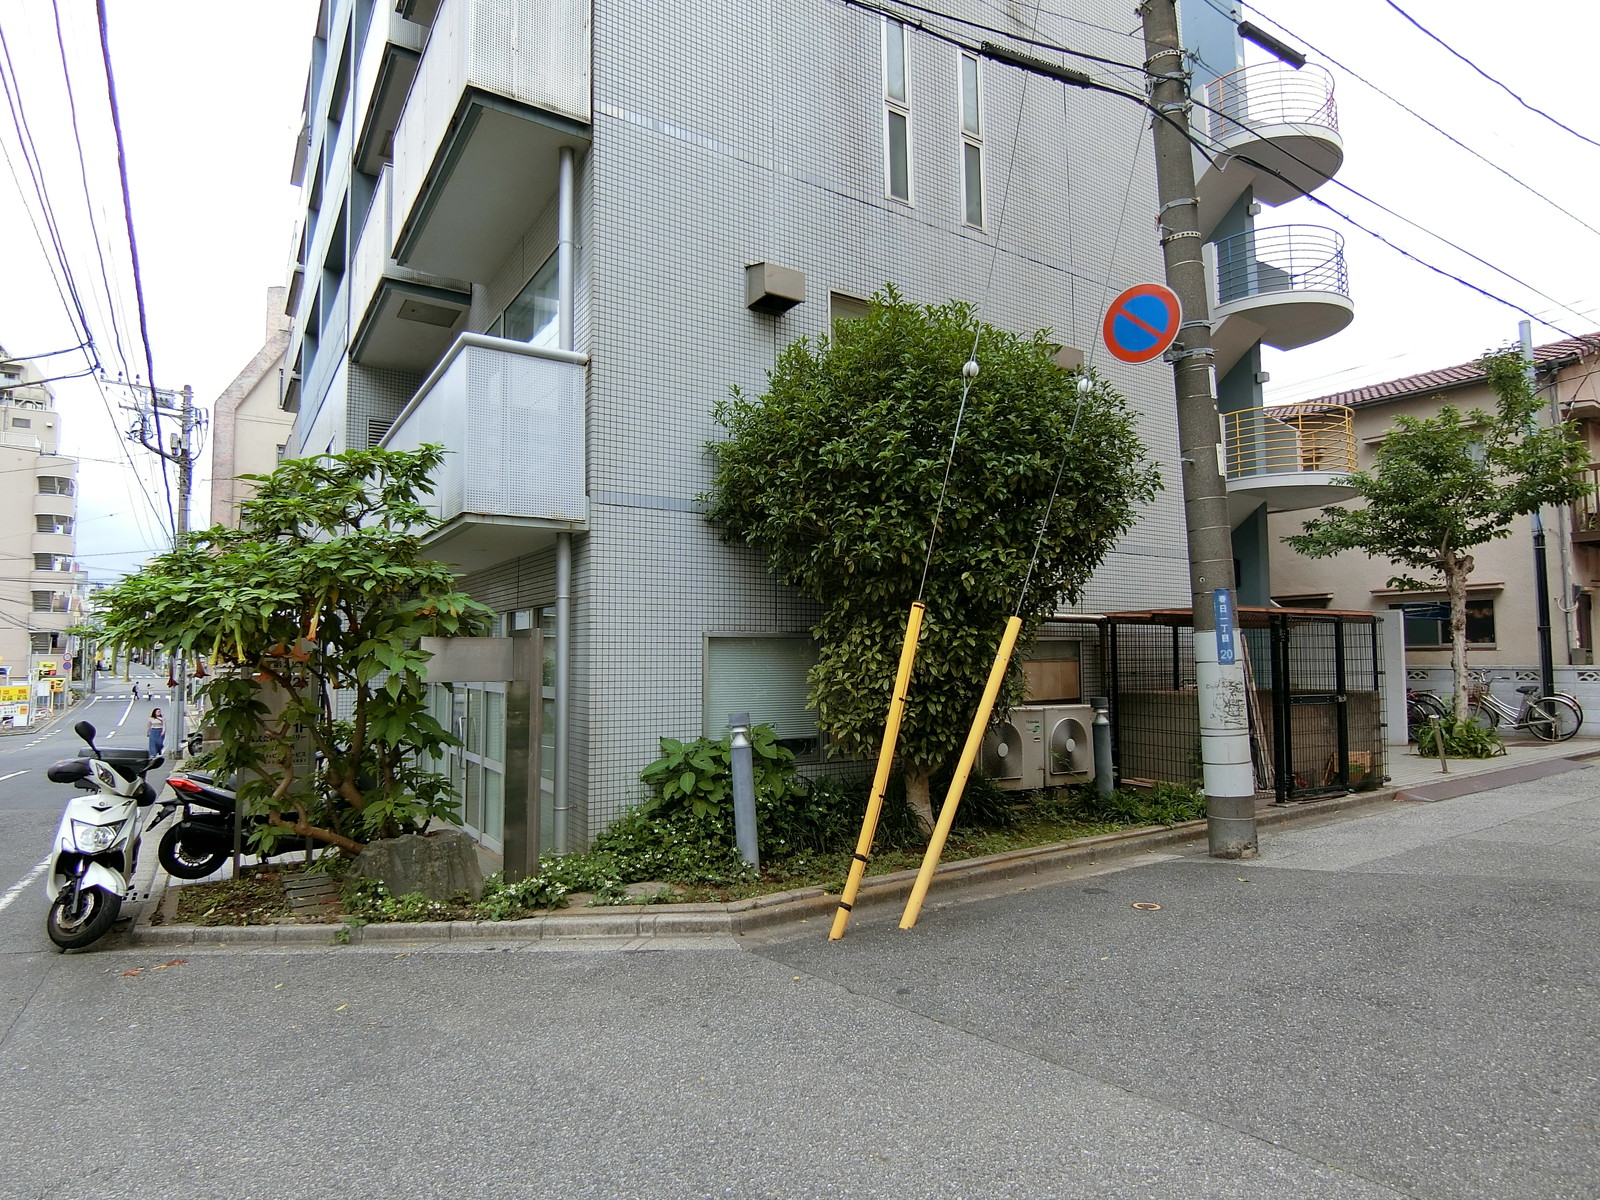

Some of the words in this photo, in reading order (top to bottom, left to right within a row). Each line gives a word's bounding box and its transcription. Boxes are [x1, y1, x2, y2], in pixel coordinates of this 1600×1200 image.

[1218, 595, 1230, 643] 春日一丁目
[1220, 649, 1233, 659] 20
